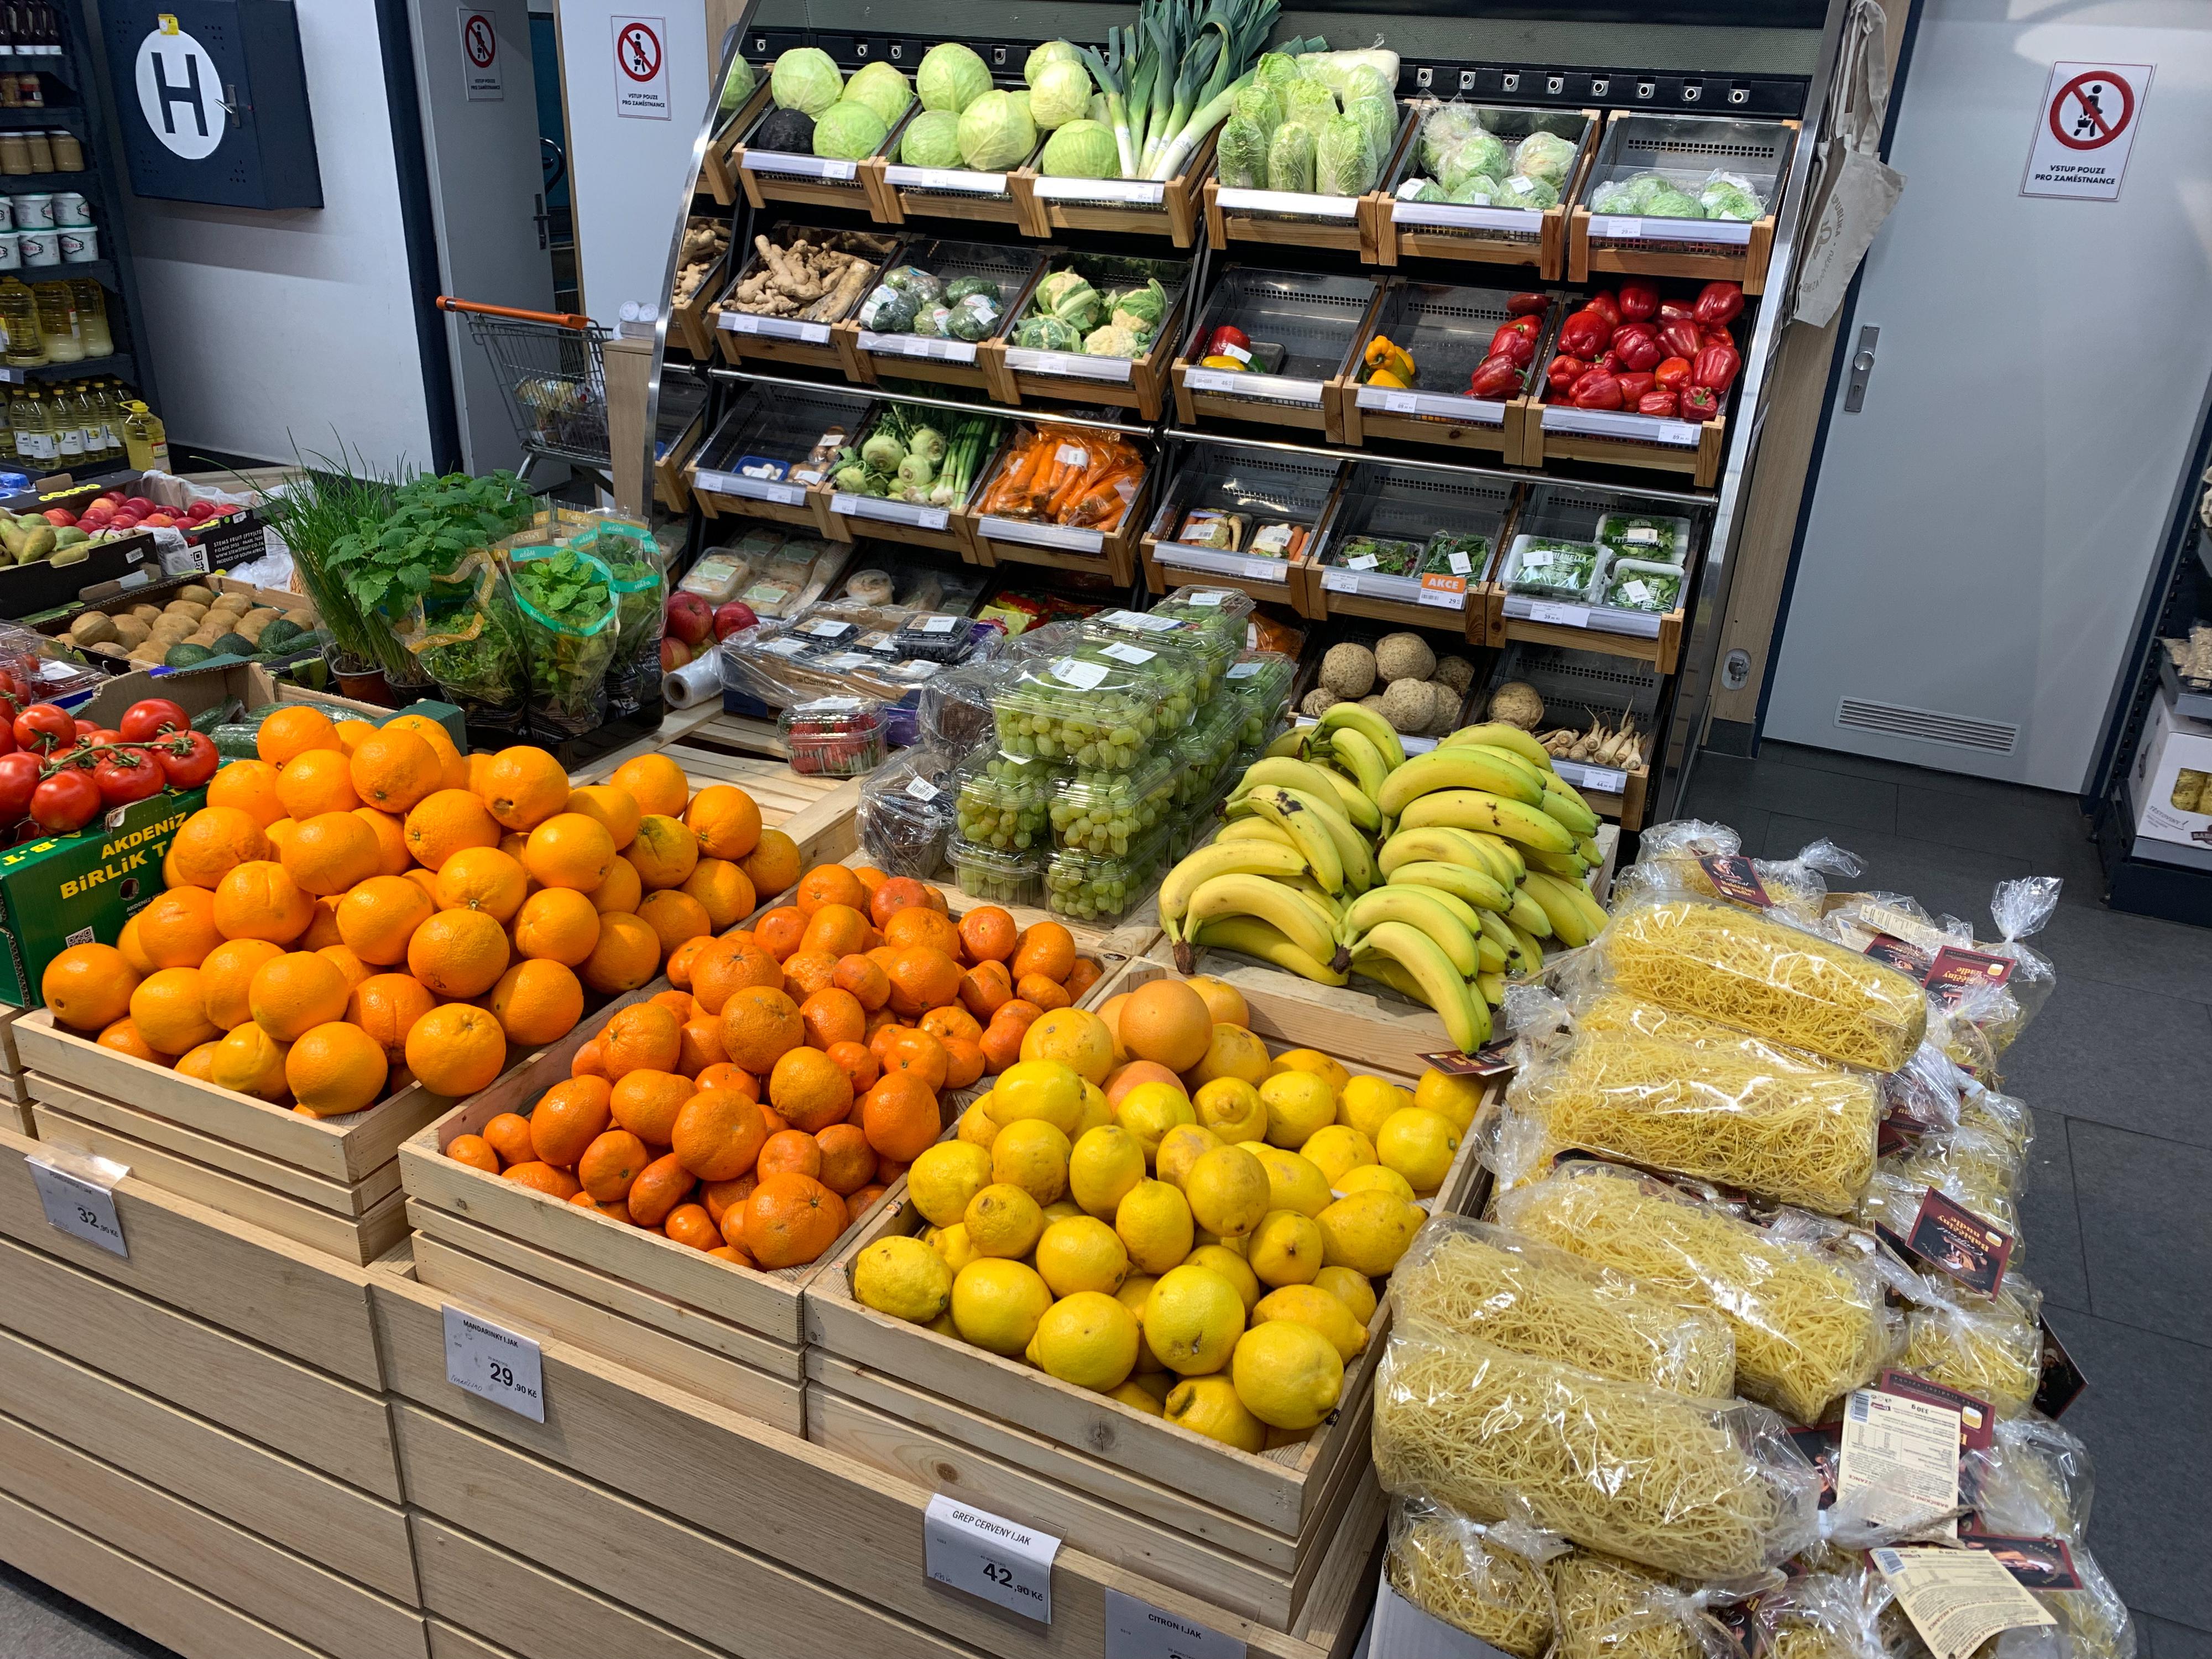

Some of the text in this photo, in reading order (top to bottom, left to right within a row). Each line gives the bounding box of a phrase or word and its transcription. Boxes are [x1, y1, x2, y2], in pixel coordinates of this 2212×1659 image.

[152, 52, 209, 137] H
[2054, 174, 2116, 185] ZAMĚSTNANCE
[213, 538, 228, 547] STEMS
[229, 535, 242, 544] FRUIT
[216, 556, 233, 565] PRODUCE
[252, 546, 265, 555] AFRICA
[634, 580, 651, 590] Máta
[1428, 577, 1459, 589] AKCE
[559, 625, 578, 635] Máta
[463, 1319, 503, 1341] MANDARINKY
[528, 1388, 537, 1398] Kč
[1917, 1406, 1929, 1415] 330
[952, 1510, 974, 1524] GREP
[975, 1519, 1011, 1537] CERVENY
[1031, 1590, 1043, 1601] Kč
[1148, 1613, 1180, 1630] CITRON
